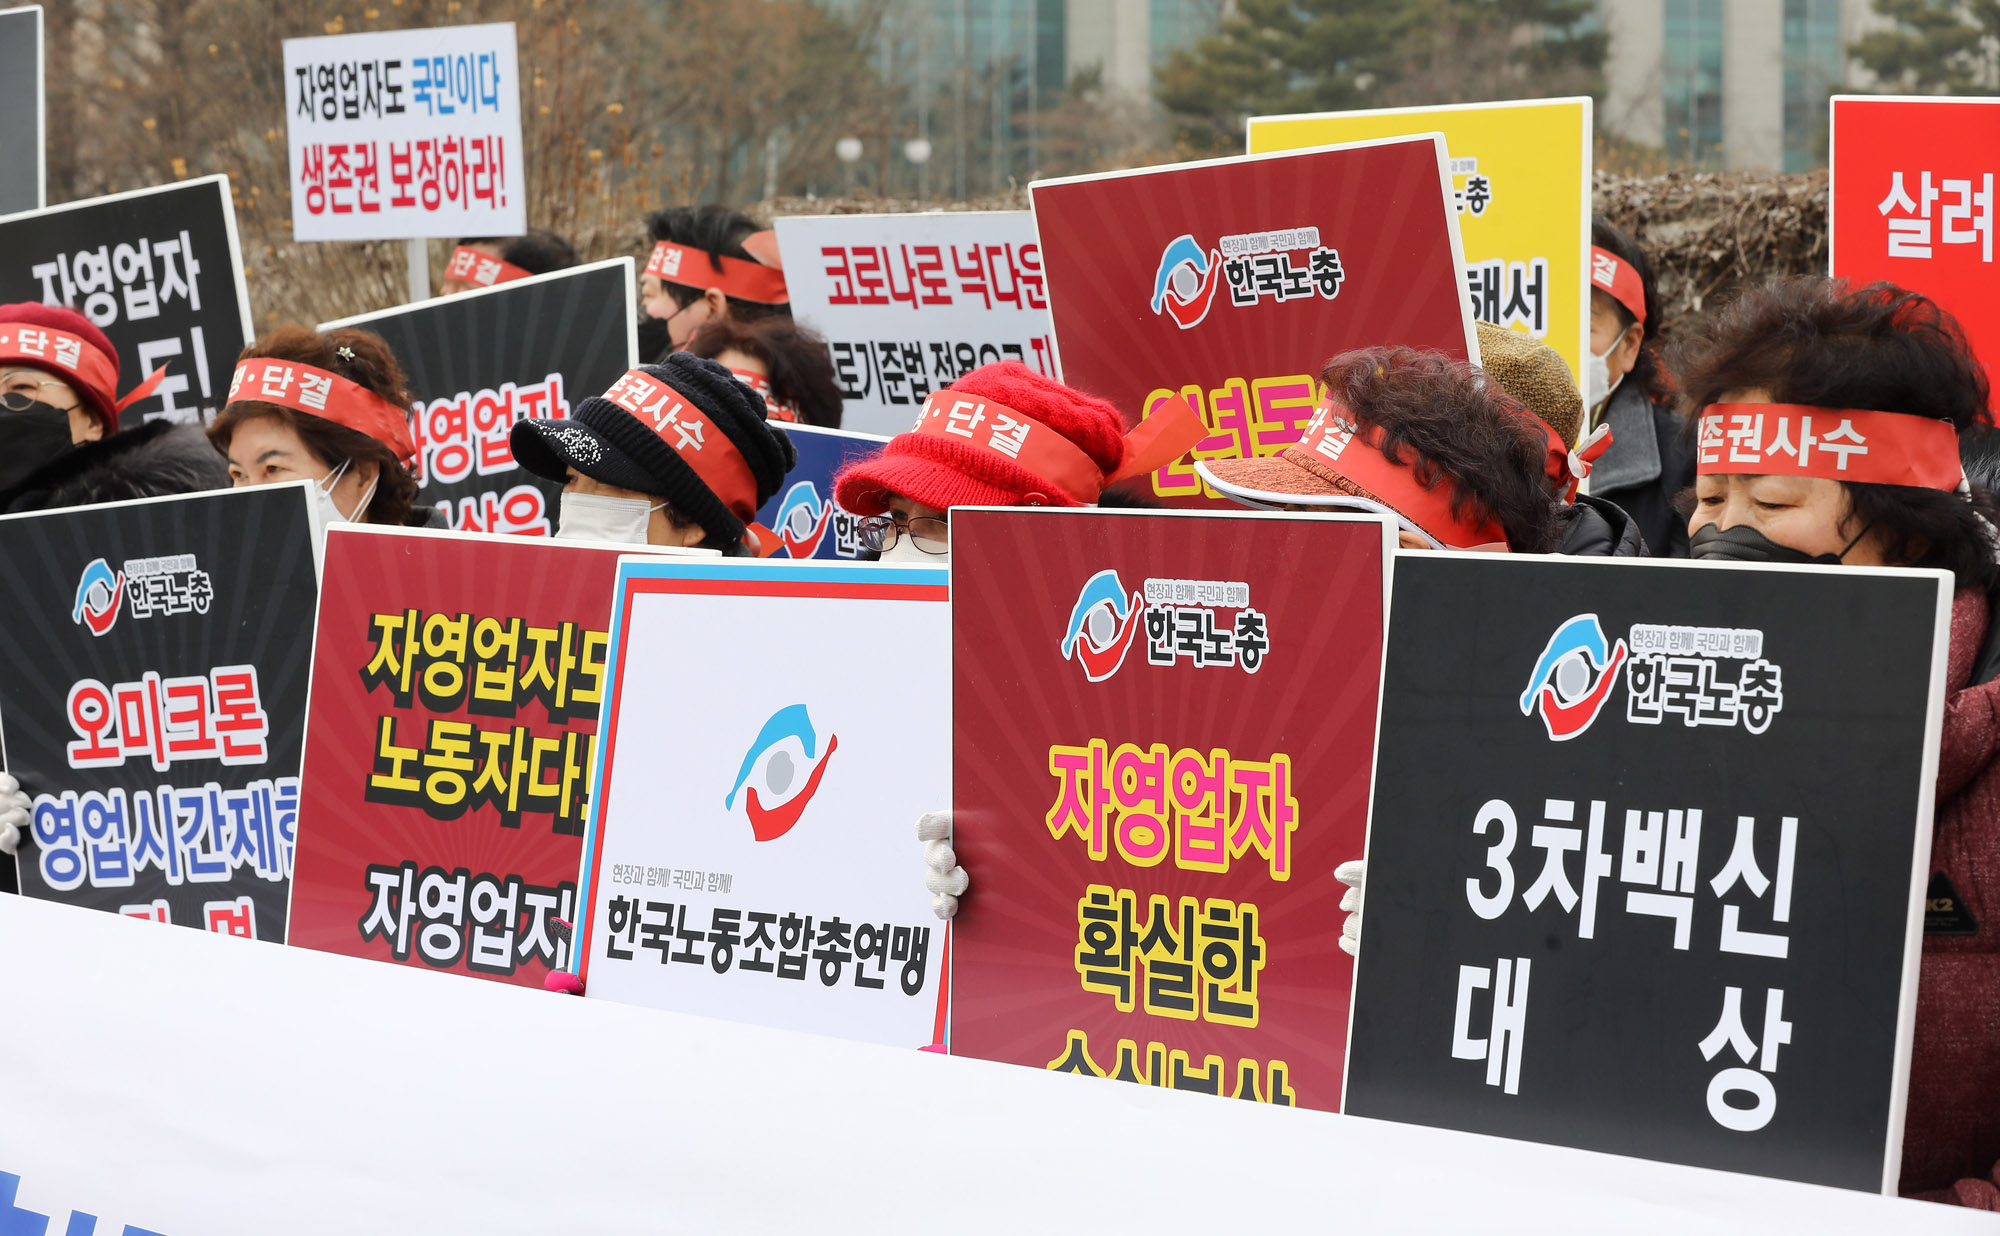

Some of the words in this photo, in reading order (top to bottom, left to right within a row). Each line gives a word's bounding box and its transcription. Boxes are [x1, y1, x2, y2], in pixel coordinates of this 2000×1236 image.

[296, 59, 405, 122] 자영업자도
[412, 51, 501, 116] 국민이다
[301, 140, 380, 215] 생존권
[389, 134, 507, 211] 보장하라!
[1222, 238, 1248, 253] 현장과
[1270, 233, 1296, 247] 국민과
[1878, 171, 1994, 262] 살려
[32, 230, 201, 328] 자영업자
[821, 243, 953, 310] 코로나로
[1226, 251, 1342, 302] 한국노총
[129, 575, 211, 611] 한국노총
[1147, 583, 1173, 599] 현장과
[1176, 584, 1195, 600] 함께!
[1198, 585, 1224, 602] 국민과
[1226, 587, 1247, 603] 함께!
[1147, 608, 1266, 669] 한국노총
[1633, 630, 1666, 648] 현장과
[1669, 631, 1694, 651] 함께!
[1697, 633, 1731, 652] 국민과
[1734, 635, 1759, 653] 함께!
[72, 673, 263, 764] 오미크론
[1631, 659, 1778, 728] 한국노총
[1051, 747, 1294, 872] 자영업자
[612, 864, 644, 886] 현장과
[647, 866, 671, 888] 함께!
[673, 869, 705, 892] 국민과
[707, 872, 733, 894] 함께!
[1466, 799, 1798, 959] 3차백신
[607, 895, 930, 997] 한국노동조합총연맹
[1079, 892, 1261, 1019] 확실한
[1451, 957, 1531, 1095] 대
[1698, 986, 1793, 1132] 상
